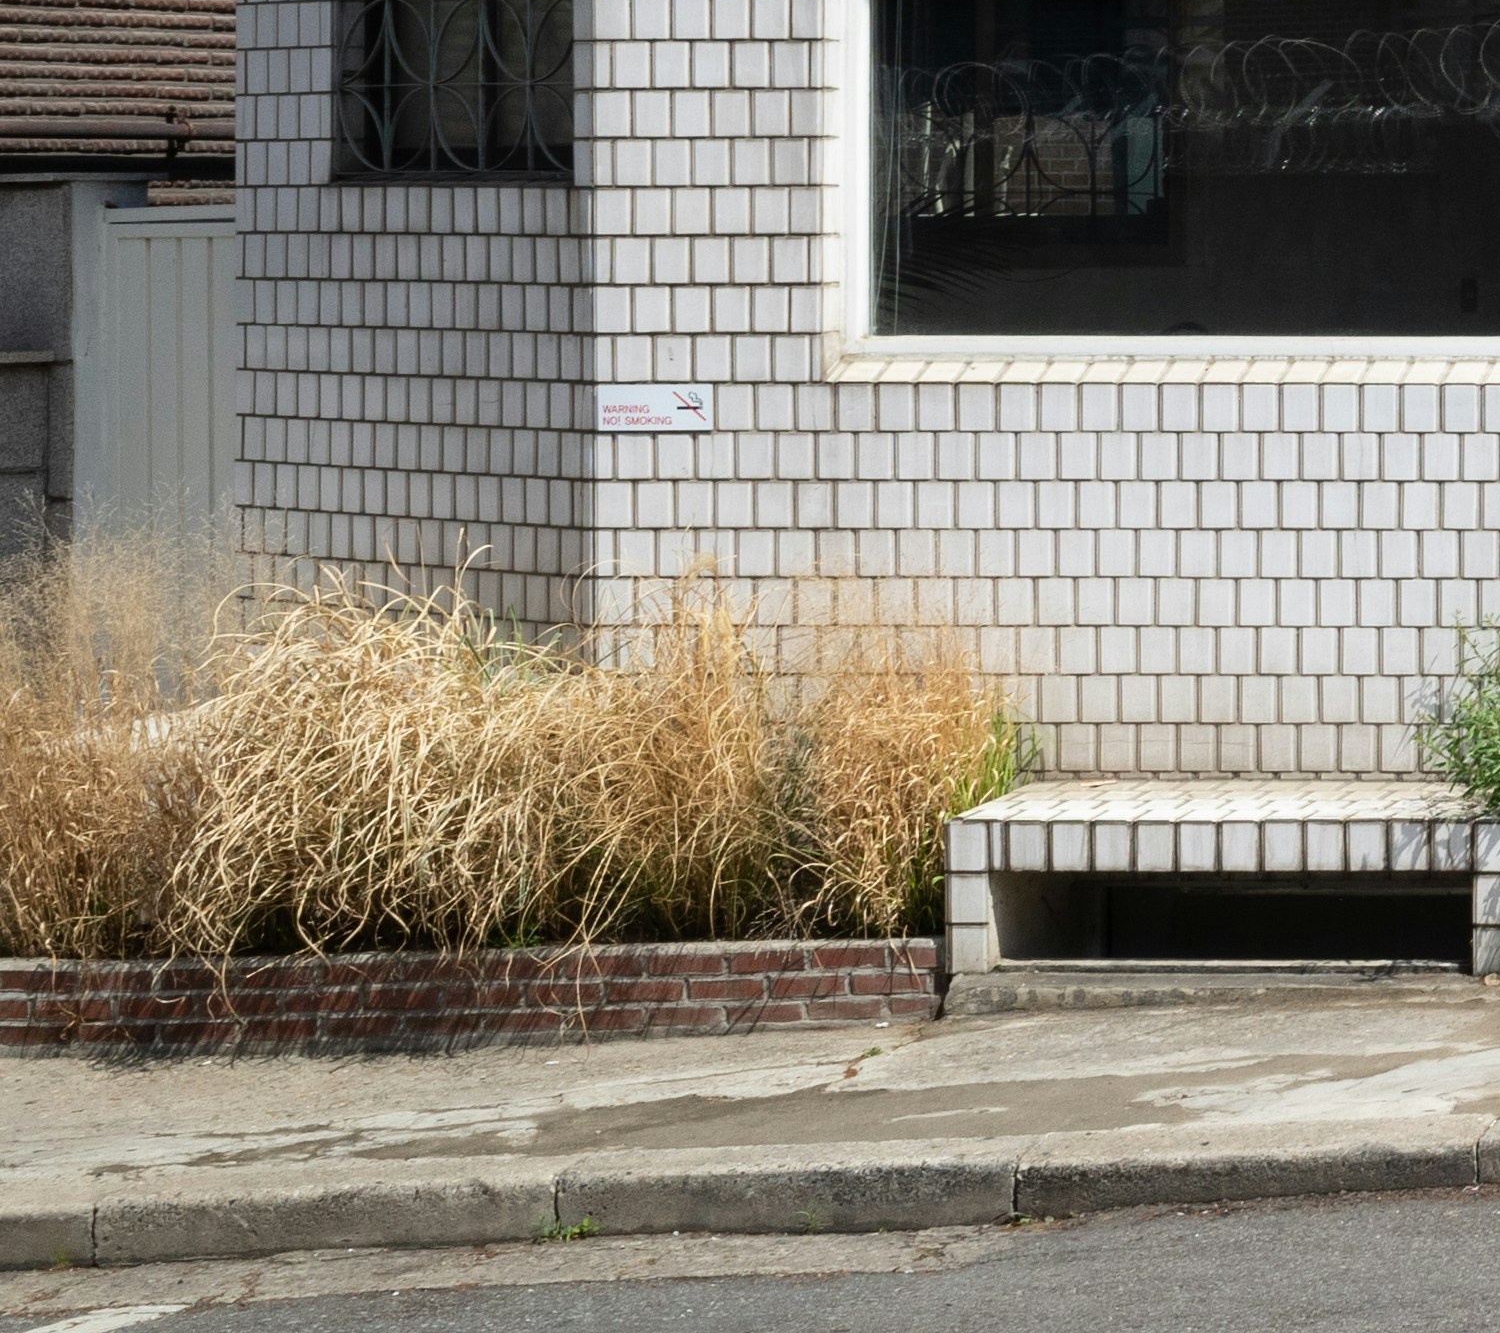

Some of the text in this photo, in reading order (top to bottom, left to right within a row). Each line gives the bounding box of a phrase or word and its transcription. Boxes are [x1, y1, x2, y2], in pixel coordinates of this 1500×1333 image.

[602, 405, 650, 414] WARNING
[602, 416, 672, 426] NO! SMOKING
